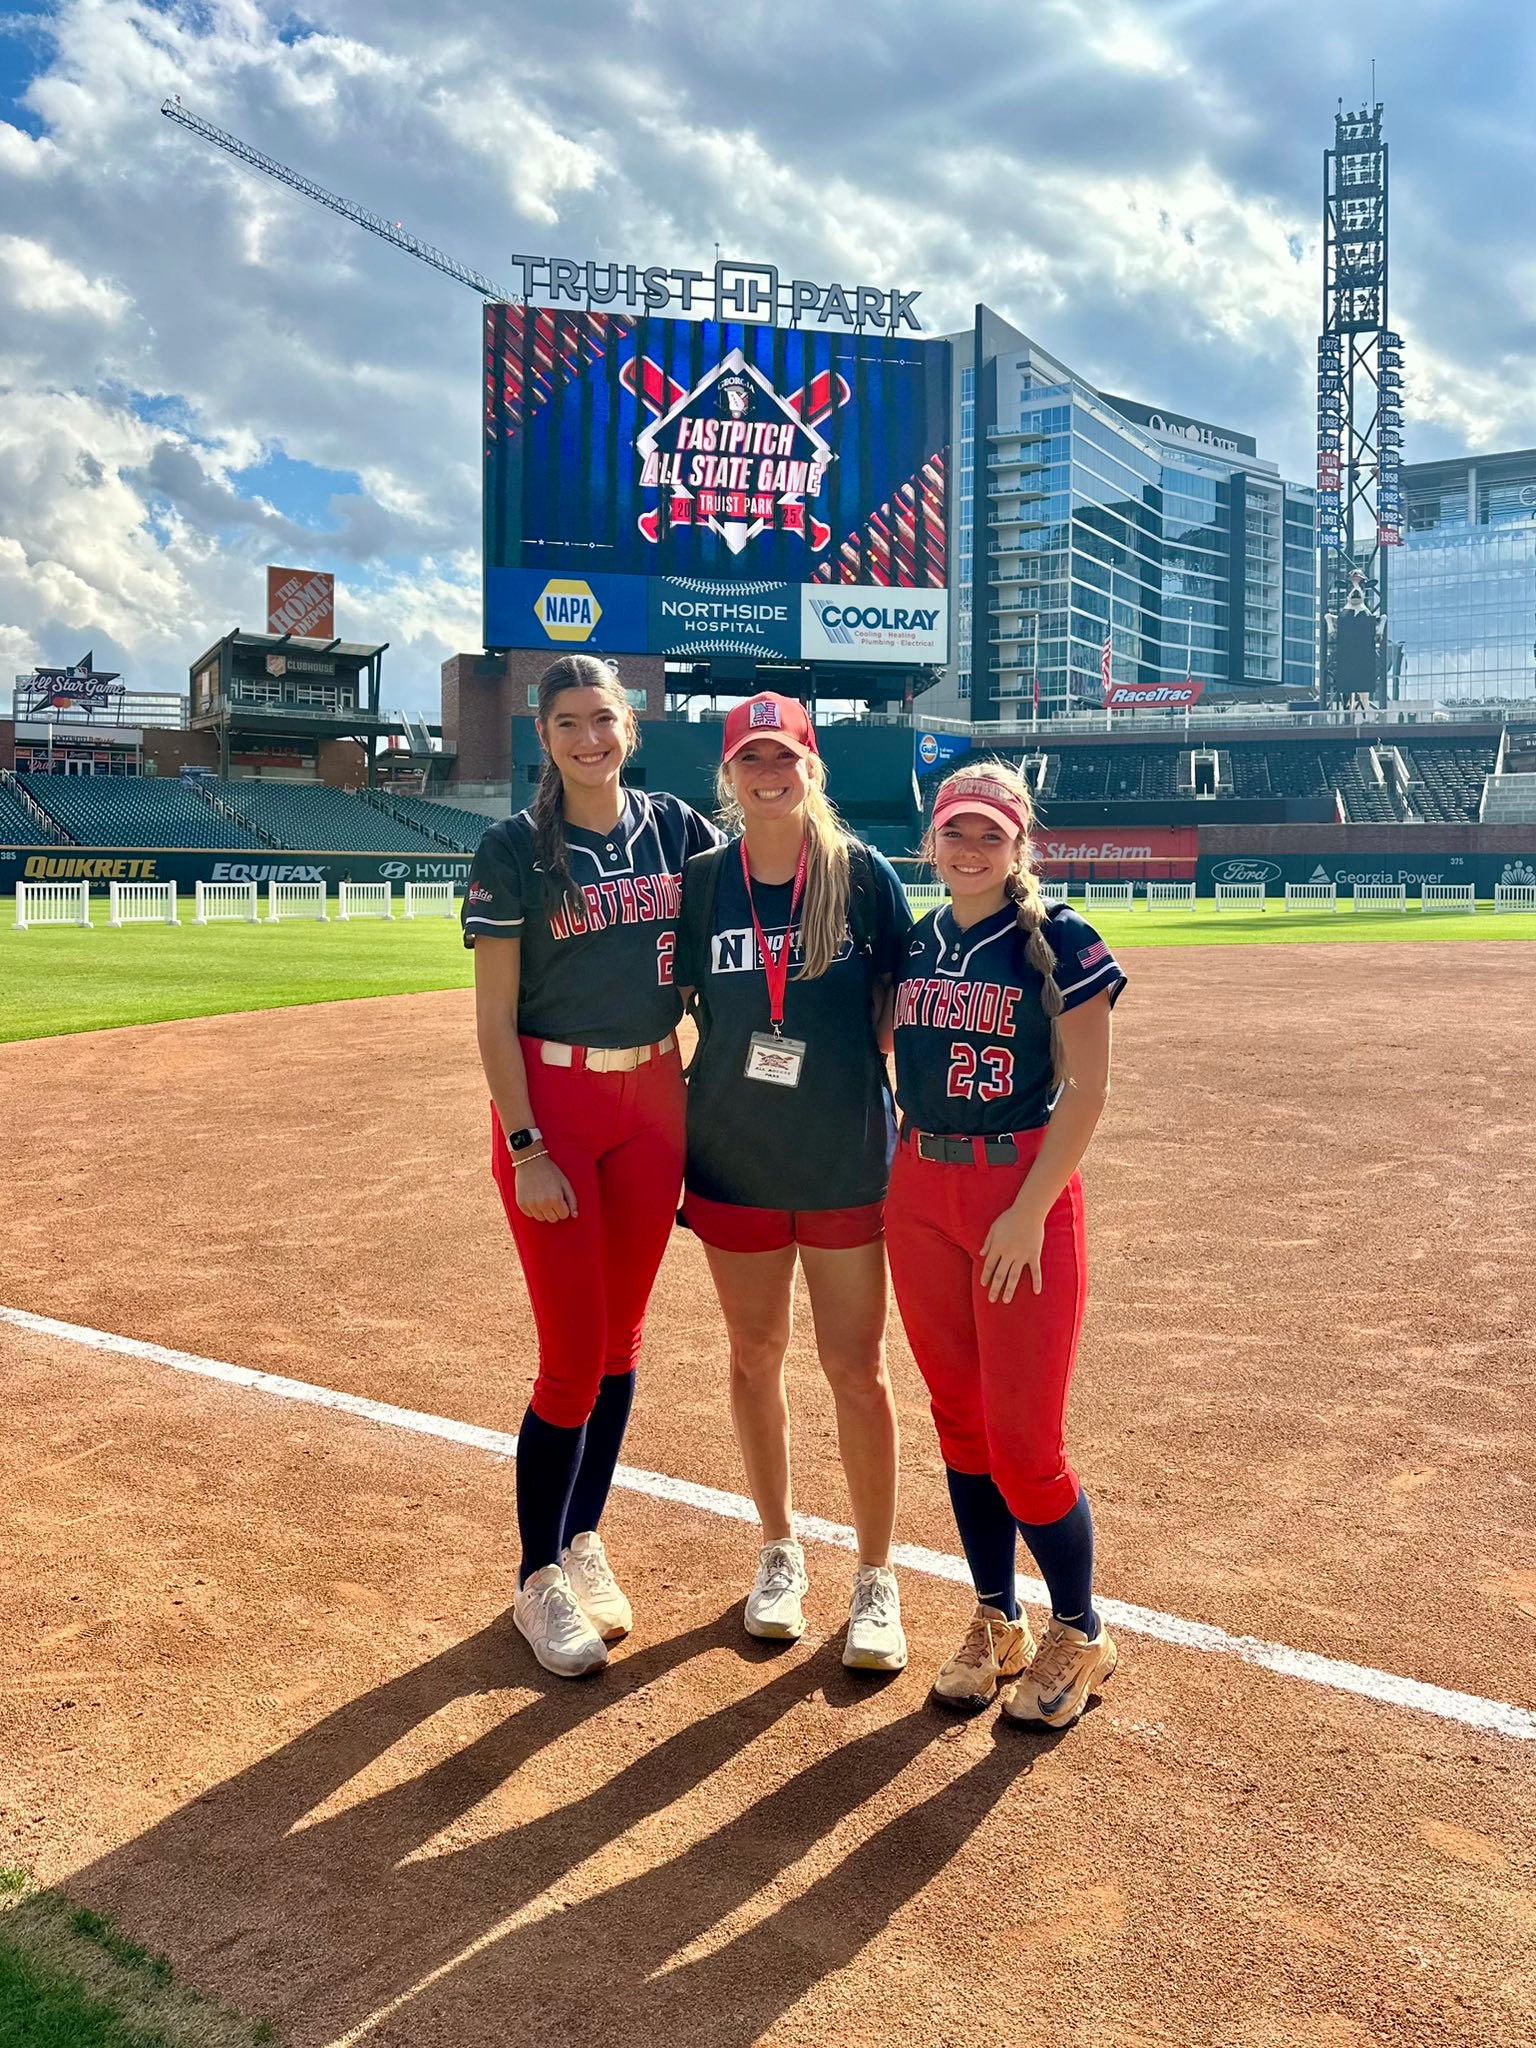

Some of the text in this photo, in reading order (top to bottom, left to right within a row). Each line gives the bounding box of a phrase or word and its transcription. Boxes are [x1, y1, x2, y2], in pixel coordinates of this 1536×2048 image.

[512, 255, 922, 330] TRUIST PARK
[1322, 340, 1338, 349] 1872
[1381, 335, 1398, 345] 1873
[1381, 355, 1398, 365] 1875
[1322, 379, 1338, 388] 1877
[1381, 394, 1398, 404] 1891
[1322, 417, 1338, 427] 1892
[1381, 413, 1398, 423] 1893
[677, 417, 796, 456] FASTPITCH
[1149, 414, 1239, 453] OMNI HOTEL
[1321, 437, 1338, 447] 1897
[1321, 457, 1338, 466] 1914
[641, 452, 821, 496] ALL STATE GAME
[1321, 476, 1338, 486] 1957
[1381, 473, 1398, 482] 1958
[677, 502, 690, 518] 20
[700, 494, 773, 514] TRUIST PARK
[782, 508, 796, 524] 25
[1321, 515, 1337, 525] 1991
[1381, 512, 1398, 522] 1992
[1321, 534, 1338, 544] 1993
[1380, 532, 1398, 542] 1995
[274, 576, 302, 602] THE
[268, 573, 334, 635] HOME
[546, 596, 592, 624] NAPA
[661, 601, 788, 621] NORTHSIDE
[293, 597, 334, 637] DEPOT
[822, 605, 940, 631] COOLRAY
[685, 620, 765, 634] HOSPITAL
[854, 630, 916, 640] Cooling Heating
[861, 638, 934, 647] Plumbing Electrical
[287, 660, 334, 673] CLUBHOUSE
[21, 676, 125, 697] All Star Game
[1111, 687, 1193, 703] RaceTrac
[1, 852, 16, 860] 385
[1046, 843, 1151, 859] State Farm
[24, 856, 156, 879] QUIKRETE
[211, 862, 325, 883] EQUIFAX
[1223, 863, 1268, 881] Ford
[1335, 871, 1444, 884] Georgia Power
[719, 935, 746, 969] N
[947, 1042, 1015, 1102] 23
